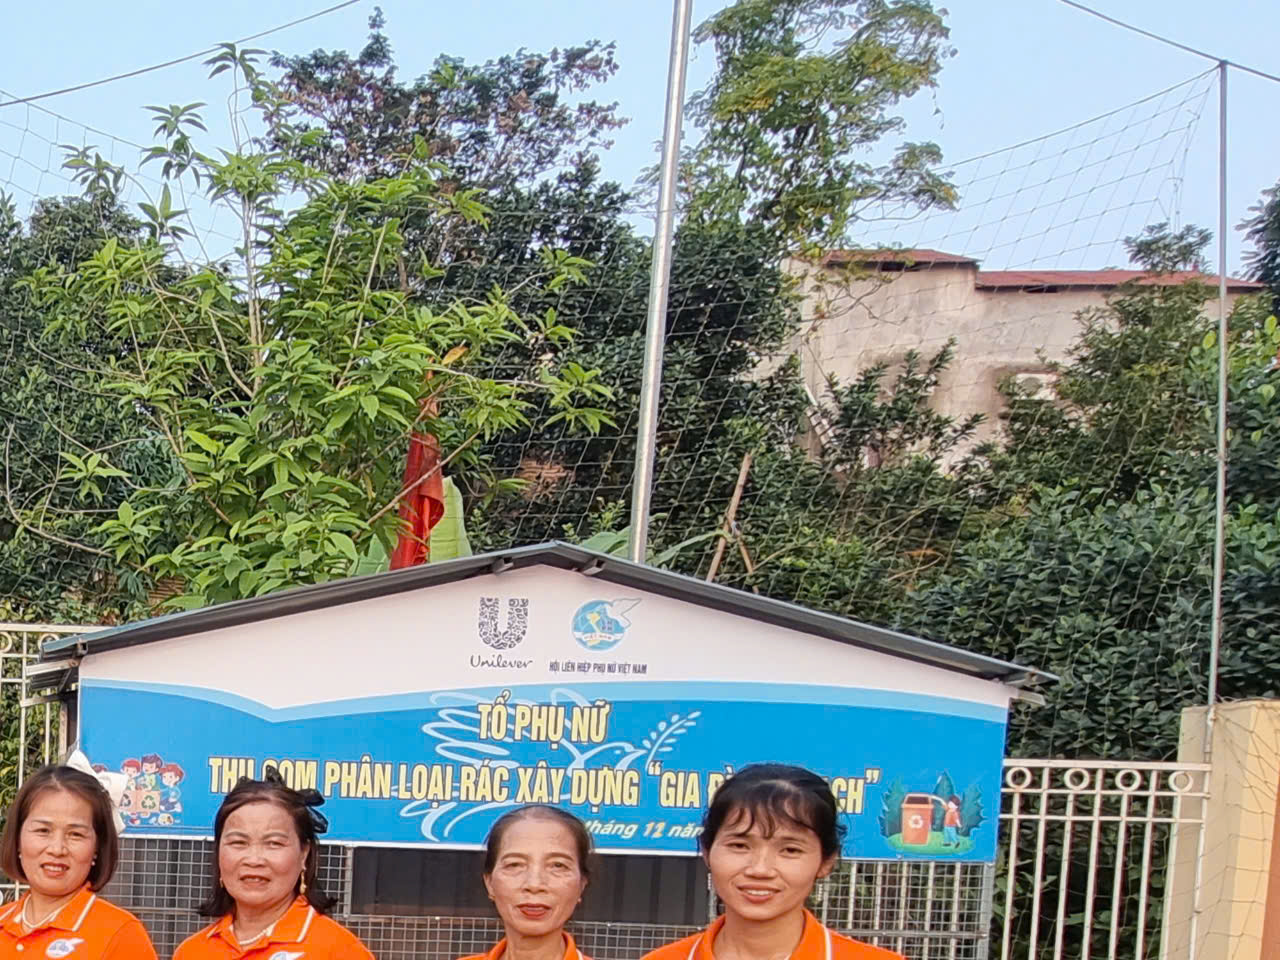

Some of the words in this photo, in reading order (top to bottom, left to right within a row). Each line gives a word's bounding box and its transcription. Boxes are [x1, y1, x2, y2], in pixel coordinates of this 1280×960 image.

[470, 654, 533, 668] Unilever
[632, 663, 647, 674] NAM
[477, 689, 511, 741] TỔ
[514, 703, 566, 750] PHỤ
[570, 699, 611, 743] NỮ
[208, 756, 255, 793] THU
[324, 753, 392, 799] PHÂN
[398, 763, 453, 809] LOẠI
[460, 758, 510, 803] RÁC
[515, 760, 565, 804] XÂY
[571, 765, 640, 814] DỰNG
